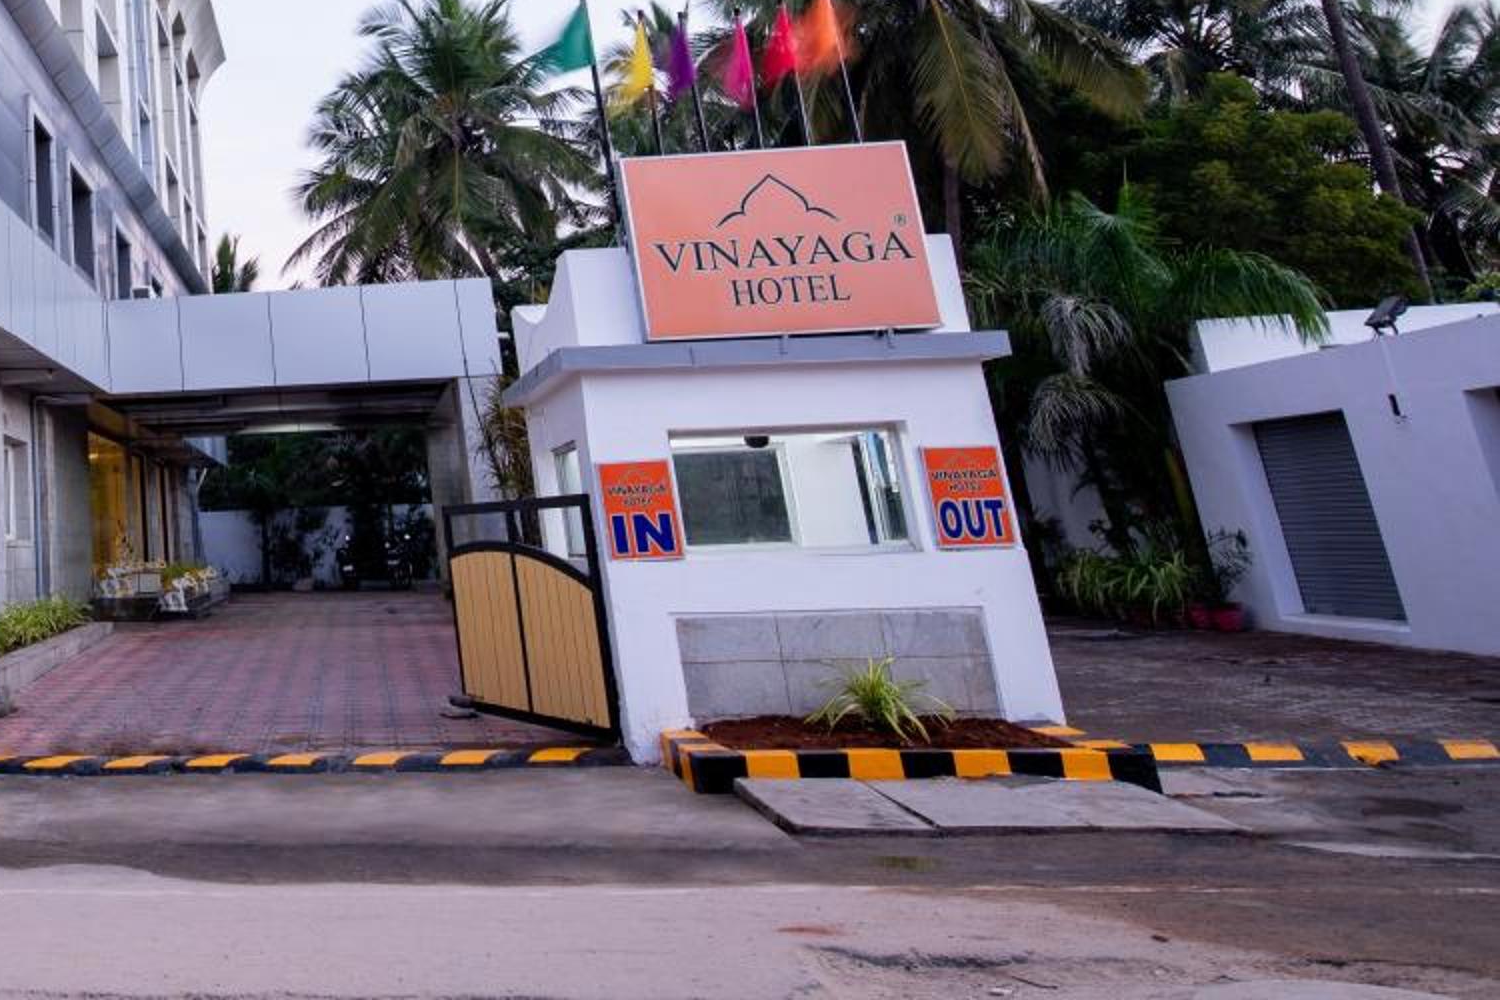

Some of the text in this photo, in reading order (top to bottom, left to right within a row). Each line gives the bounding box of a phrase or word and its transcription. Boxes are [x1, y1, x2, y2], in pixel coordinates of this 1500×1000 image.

[654, 230, 916, 273] VINAYAGA
[730, 273, 852, 307] HOTEL
[611, 512, 676, 555] IN
[939, 499, 1004, 539] OUT
